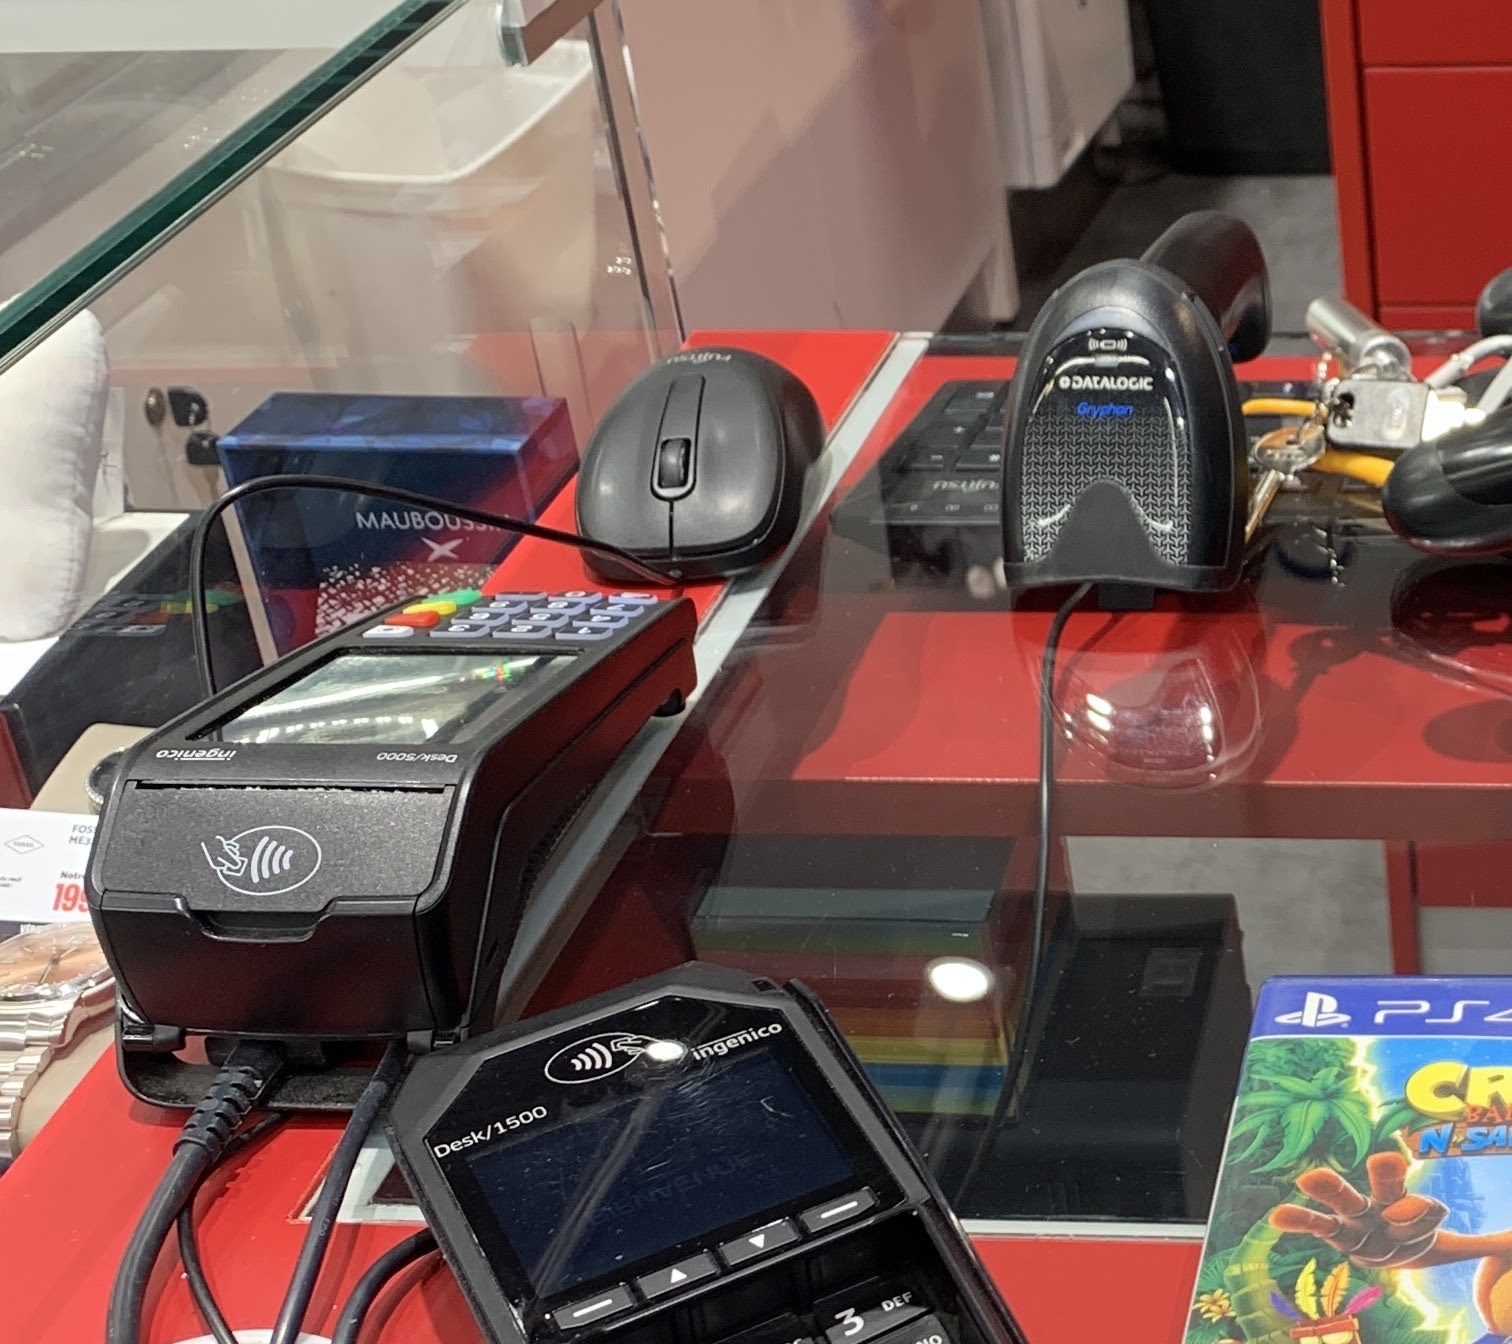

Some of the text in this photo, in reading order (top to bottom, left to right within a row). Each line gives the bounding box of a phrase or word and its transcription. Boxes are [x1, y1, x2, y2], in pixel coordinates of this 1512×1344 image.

[1071, 376, 1153, 391] DATALOGIC
[1077, 401, 1134, 418] Gryphon
[156, 748, 237, 762] ingenico
[376, 752, 459, 763] Desk/5000
[60, 871, 85, 879] Notr
[690, 1022, 783, 1062] ingenico
[433, 1105, 548, 1158] Desk/1500
[834, 1292, 912, 1336] 3 DEF
